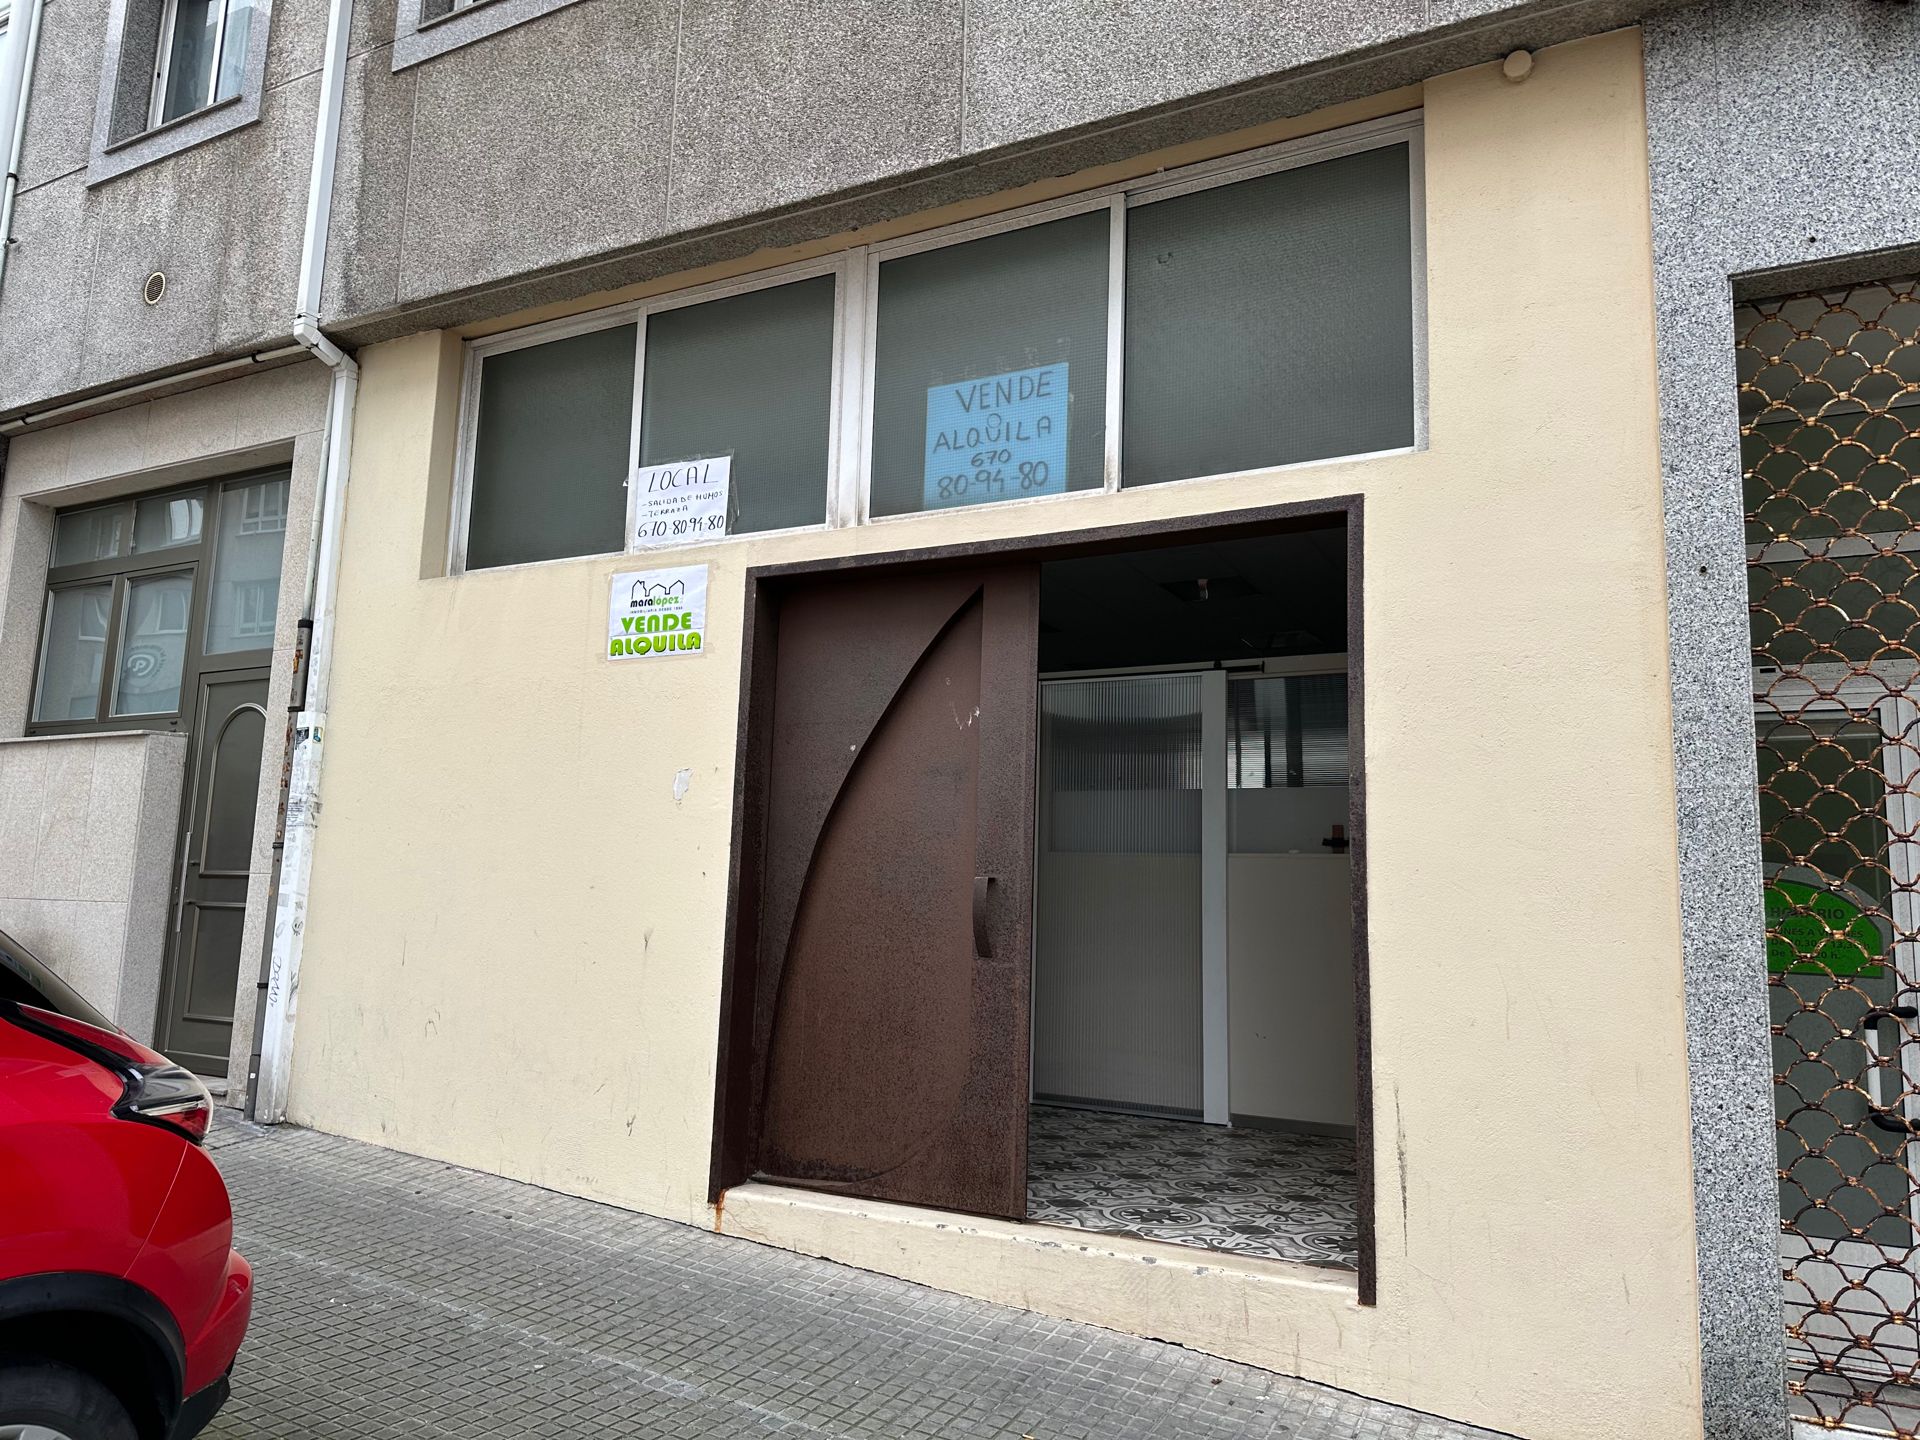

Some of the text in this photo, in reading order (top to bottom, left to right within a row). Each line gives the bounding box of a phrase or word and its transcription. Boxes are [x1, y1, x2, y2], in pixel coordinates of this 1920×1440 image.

[955, 371, 1054, 413] VENDE
[933, 415, 1052, 454] ALQUILA
[971, 449, 1011, 467] 670
[648, 463, 719, 493] LOCAL
[680, 494, 693, 503] DE
[695, 490, 723, 501] HUMOS
[621, 612, 692, 634] VENDE
[610, 631, 702, 656] ALQUILA
[1770, 906, 1845, 920] HRIO
